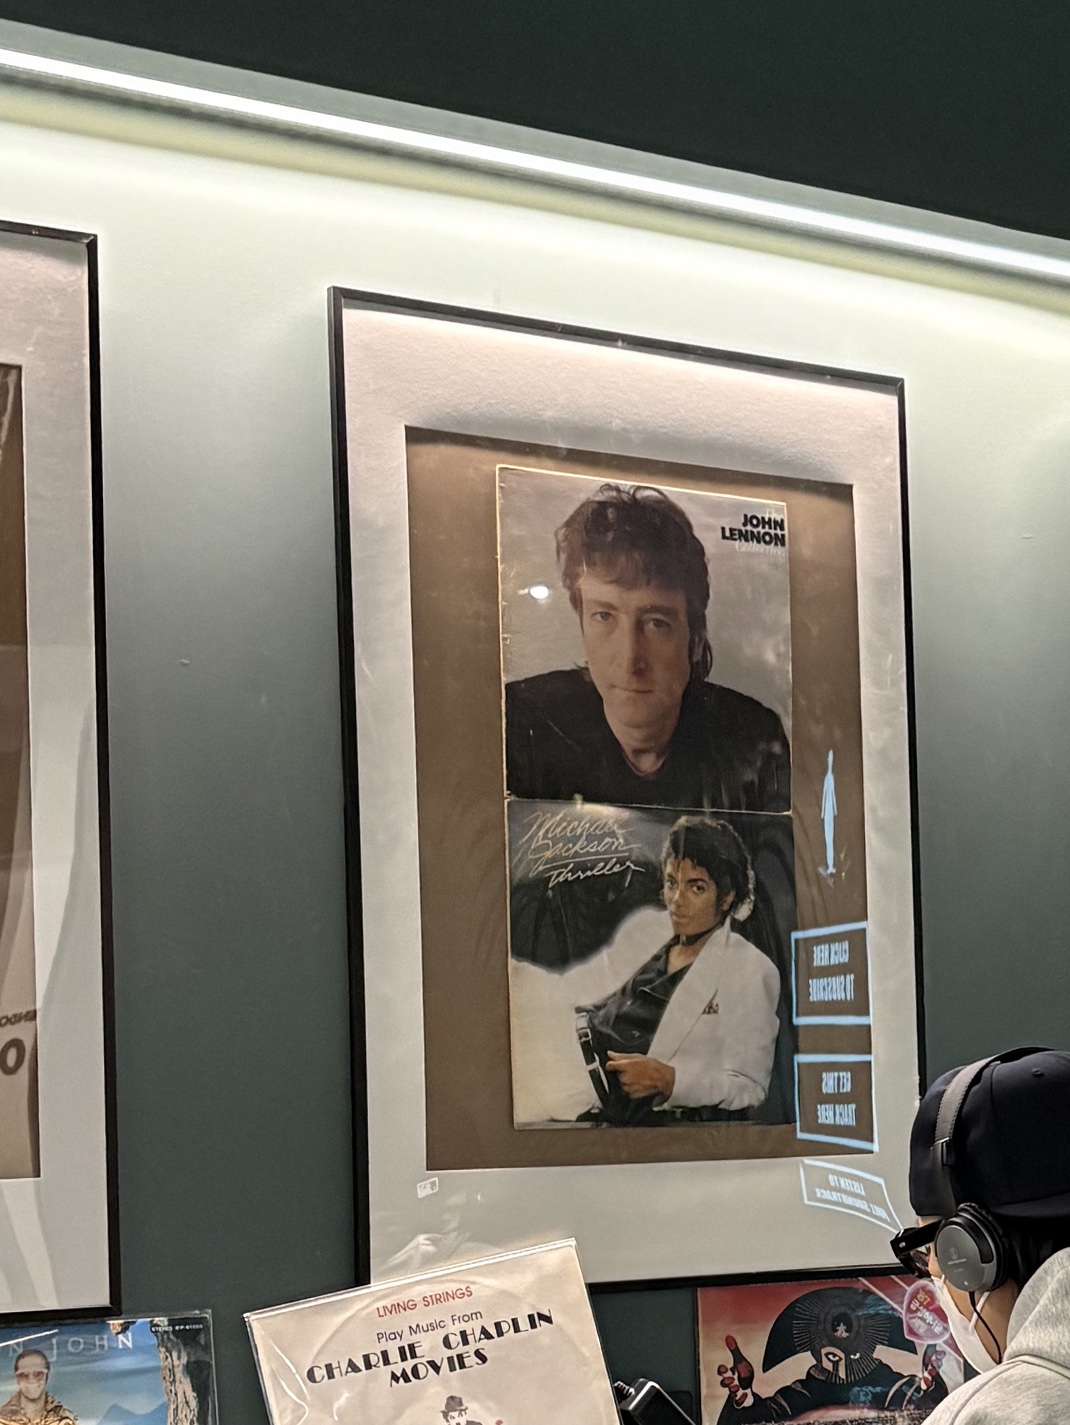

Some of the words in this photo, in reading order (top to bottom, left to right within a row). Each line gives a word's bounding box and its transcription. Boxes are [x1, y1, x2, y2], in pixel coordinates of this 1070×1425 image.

[721, 526, 786, 547] LENNON
[742, 513, 785, 532] JOHN
[528, 835, 641, 877] Jackson
[545, 858, 646, 888] Thriller
[376, 1299, 418, 1318] LIVING
[422, 1285, 473, 1308] STRINGS
[376, 1328, 405, 1344] Play
[408, 1318, 447, 1337] Music
[450, 1310, 483, 1326] From
[49, 1331, 134, 1362] JOHN
[306, 1340, 425, 1384] CHARLIE
[442, 1308, 554, 1350] CHAPLIN
[389, 1347, 489, 1388] MOVIES
